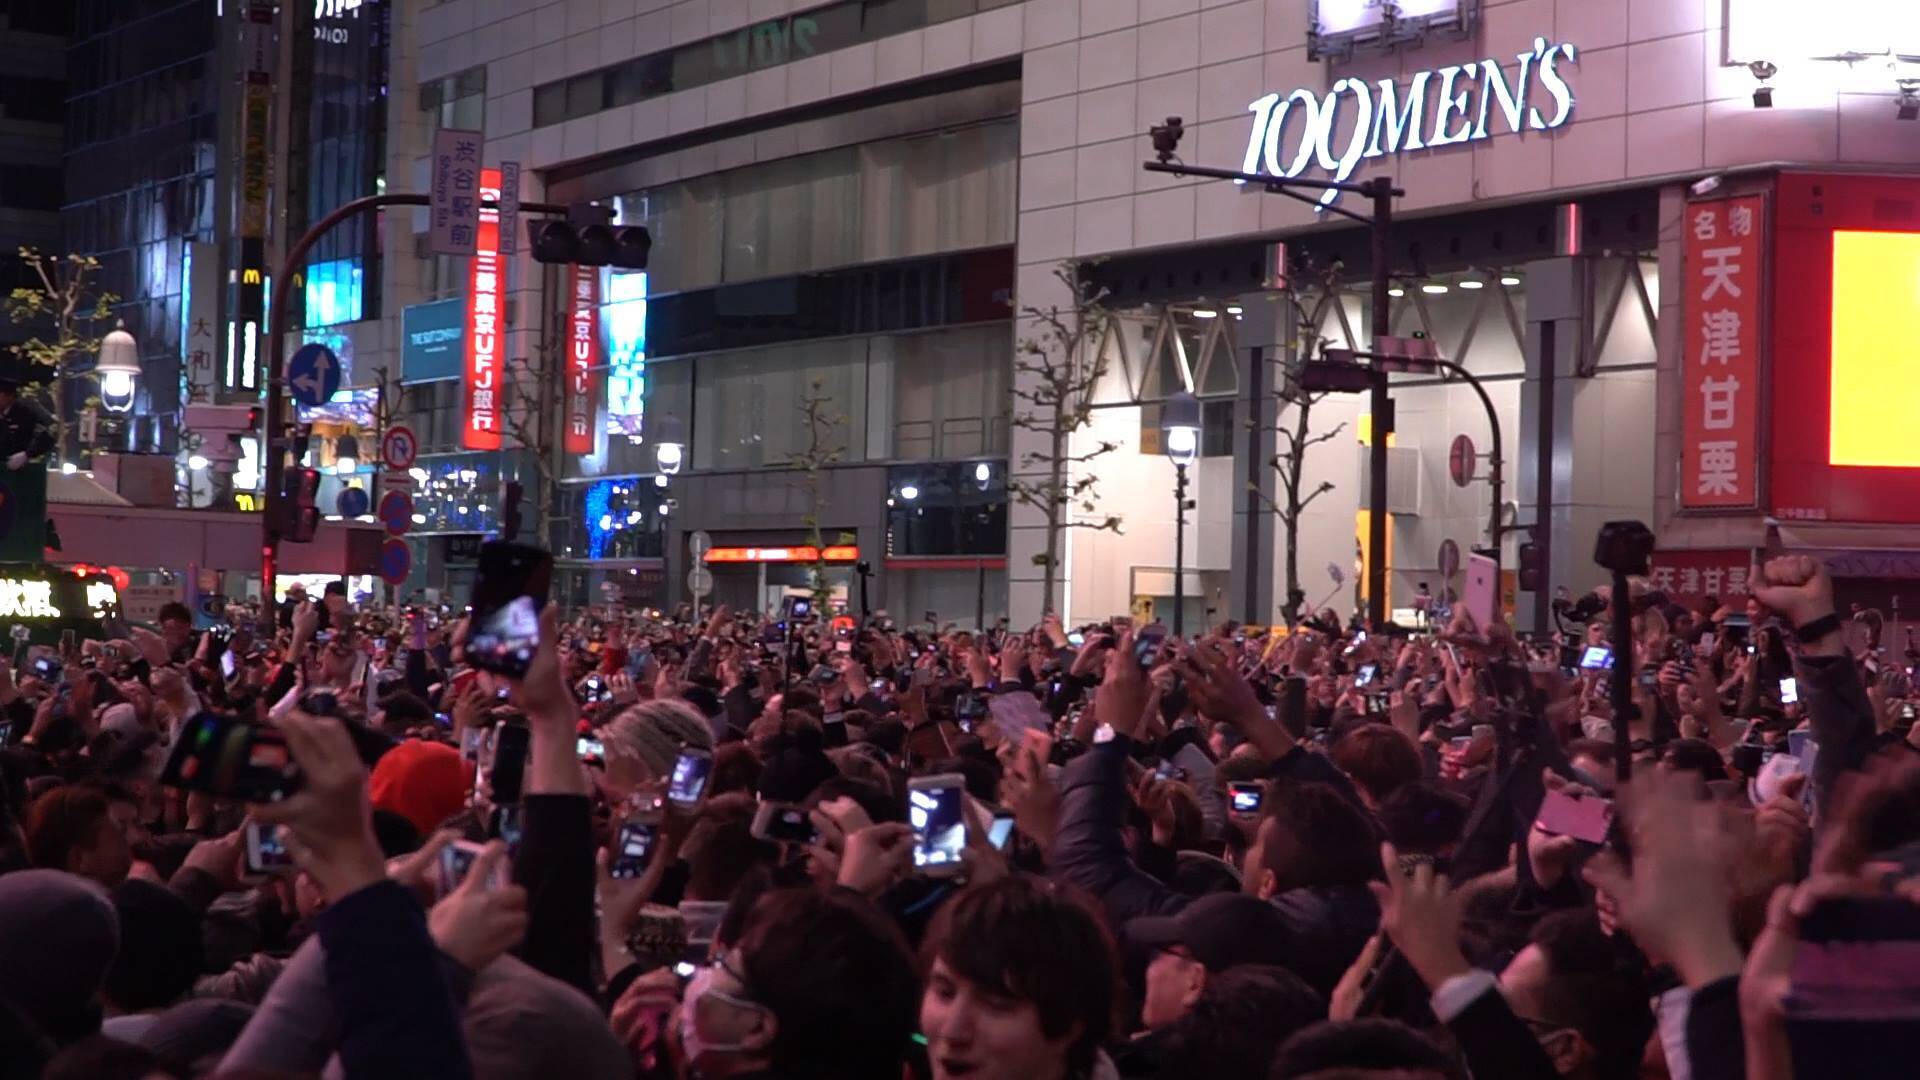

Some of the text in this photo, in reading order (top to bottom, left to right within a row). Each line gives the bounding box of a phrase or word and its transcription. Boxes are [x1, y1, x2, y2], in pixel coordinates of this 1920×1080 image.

[449, 141, 475, 247] 渋谷駅前
[1693, 205, 1752, 240] 名物
[471, 250, 497, 431] 三菱東京UFJ銀行
[1698, 246, 1743, 495] 天津甘栗
[1653, 566, 1748, 595] 天津甘栗
